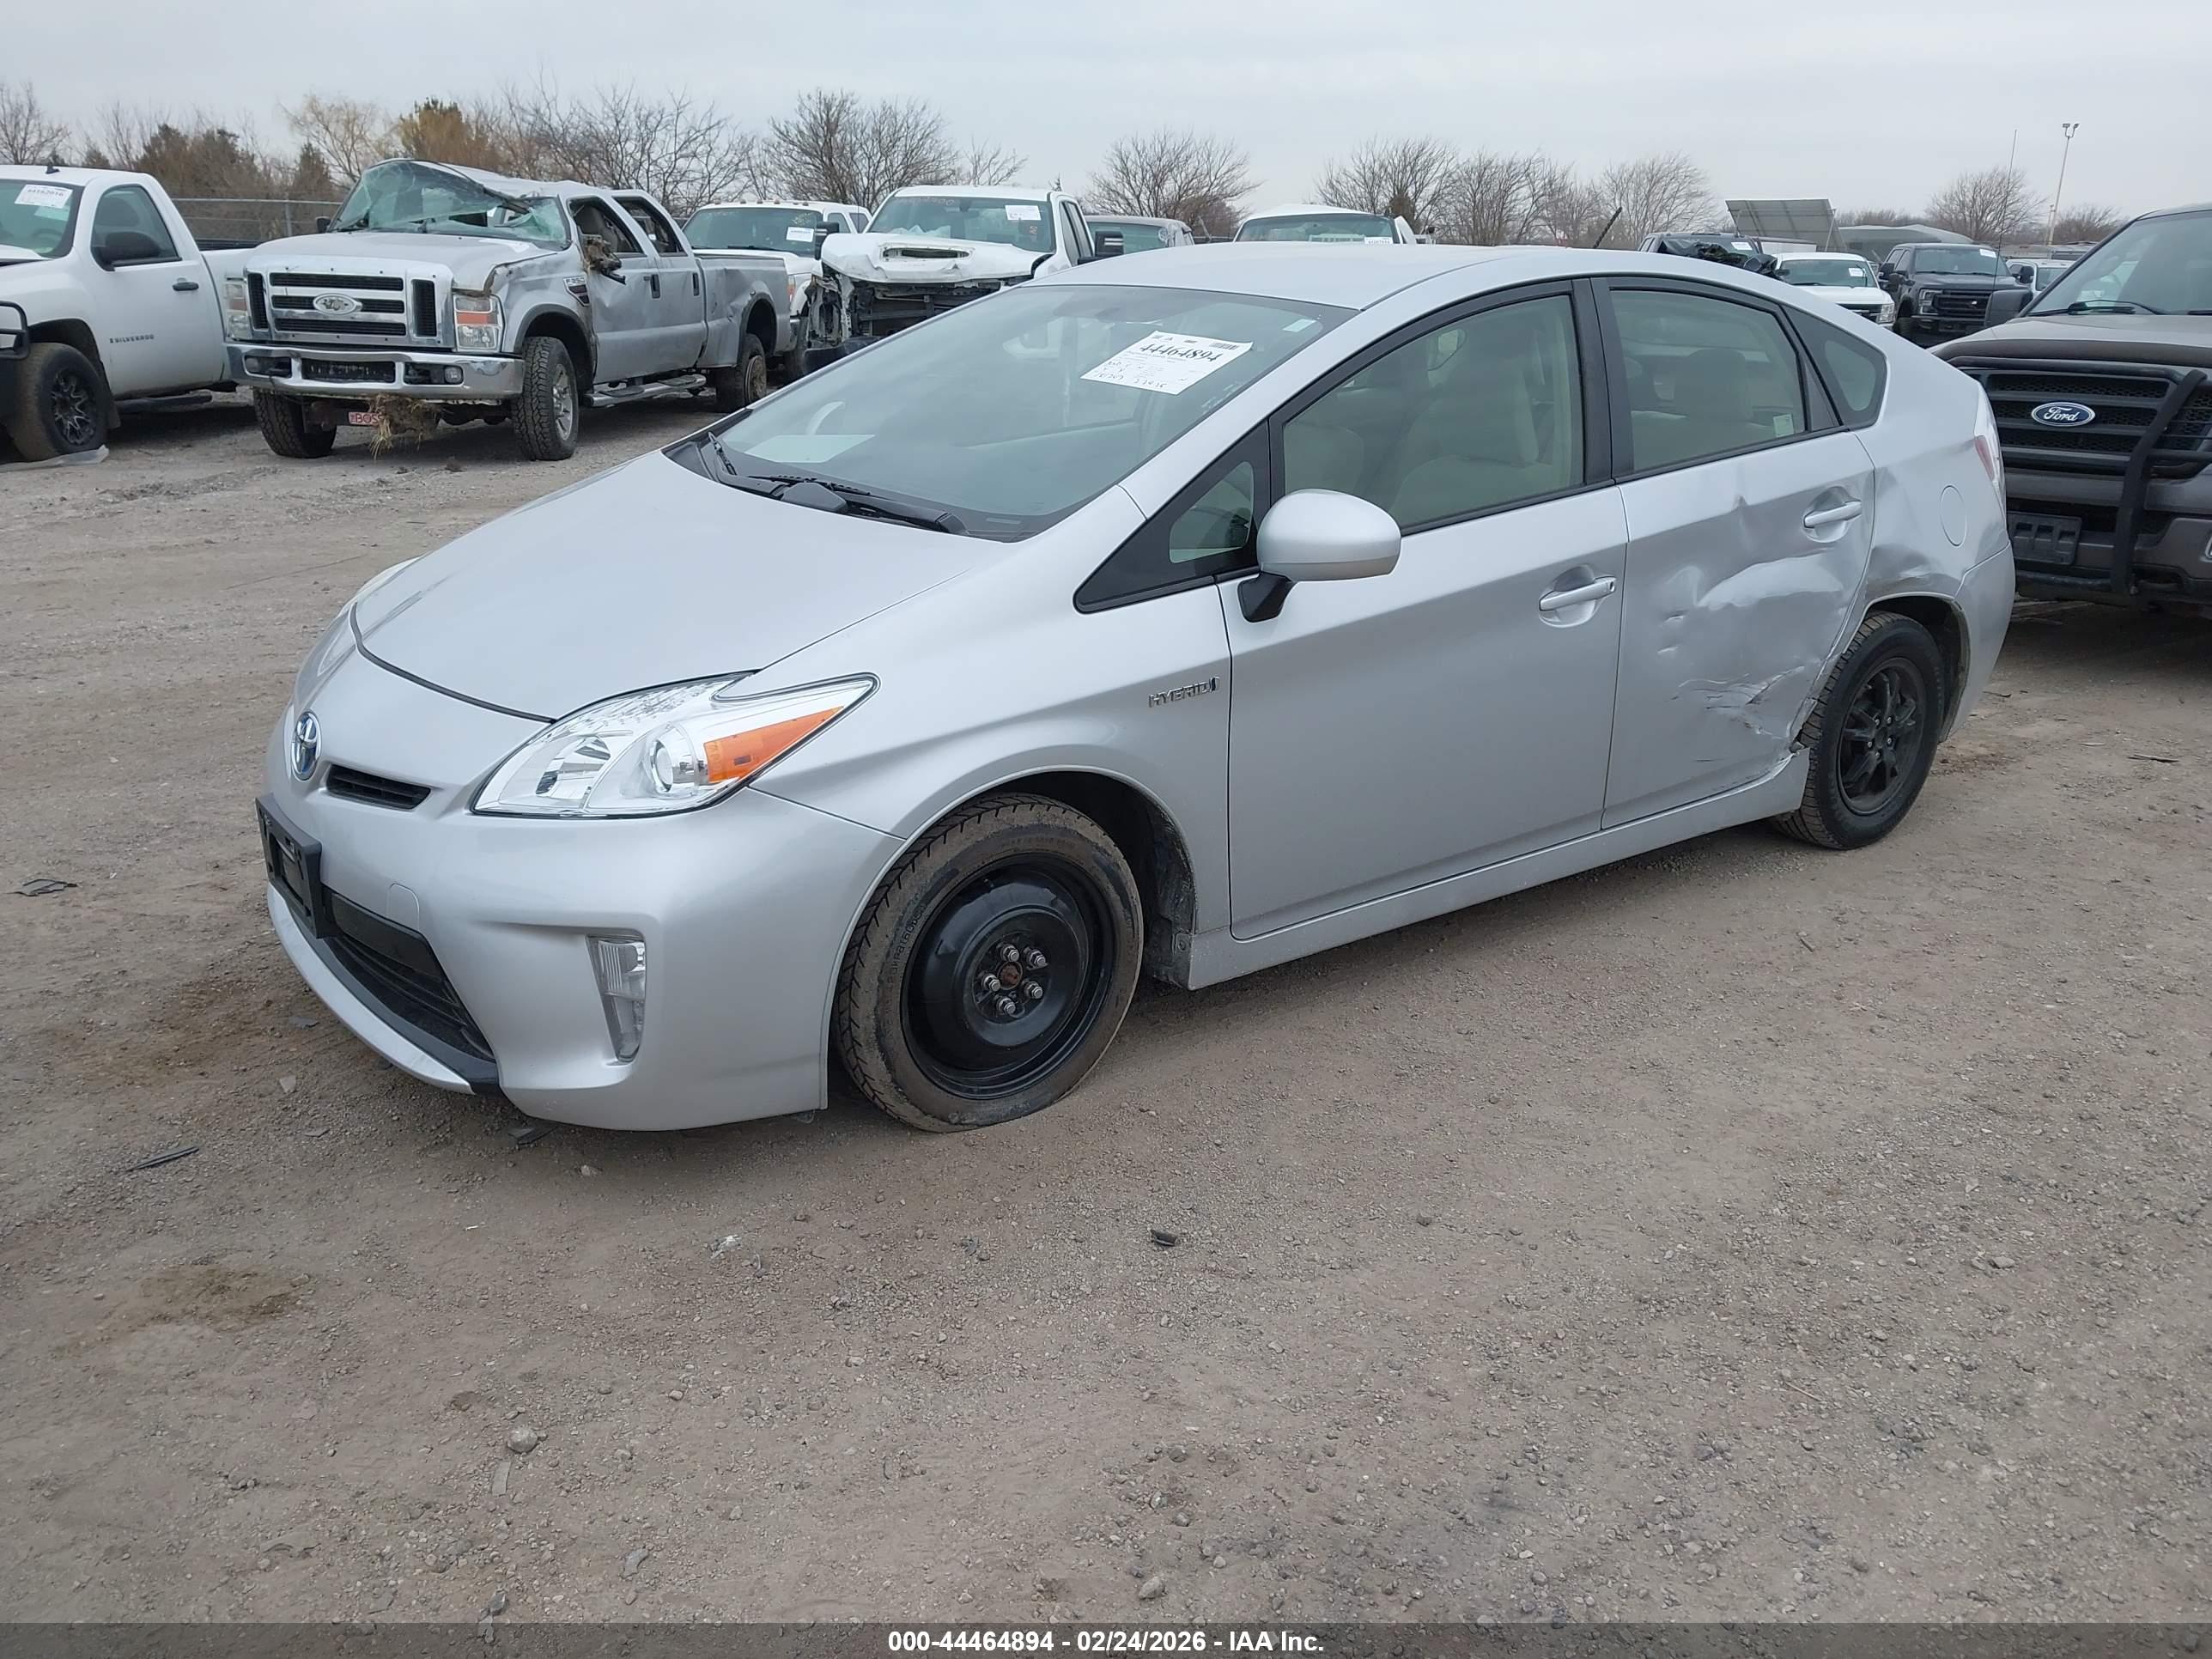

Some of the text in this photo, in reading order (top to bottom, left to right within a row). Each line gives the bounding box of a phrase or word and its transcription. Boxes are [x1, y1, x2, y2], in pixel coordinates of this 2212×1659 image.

[114, 333, 155, 343] SILVERADO
[1140, 343, 1224, 362] 44464894
[2044, 406, 2080, 422] Ford
[1148, 678, 1216, 708] HYBRID
